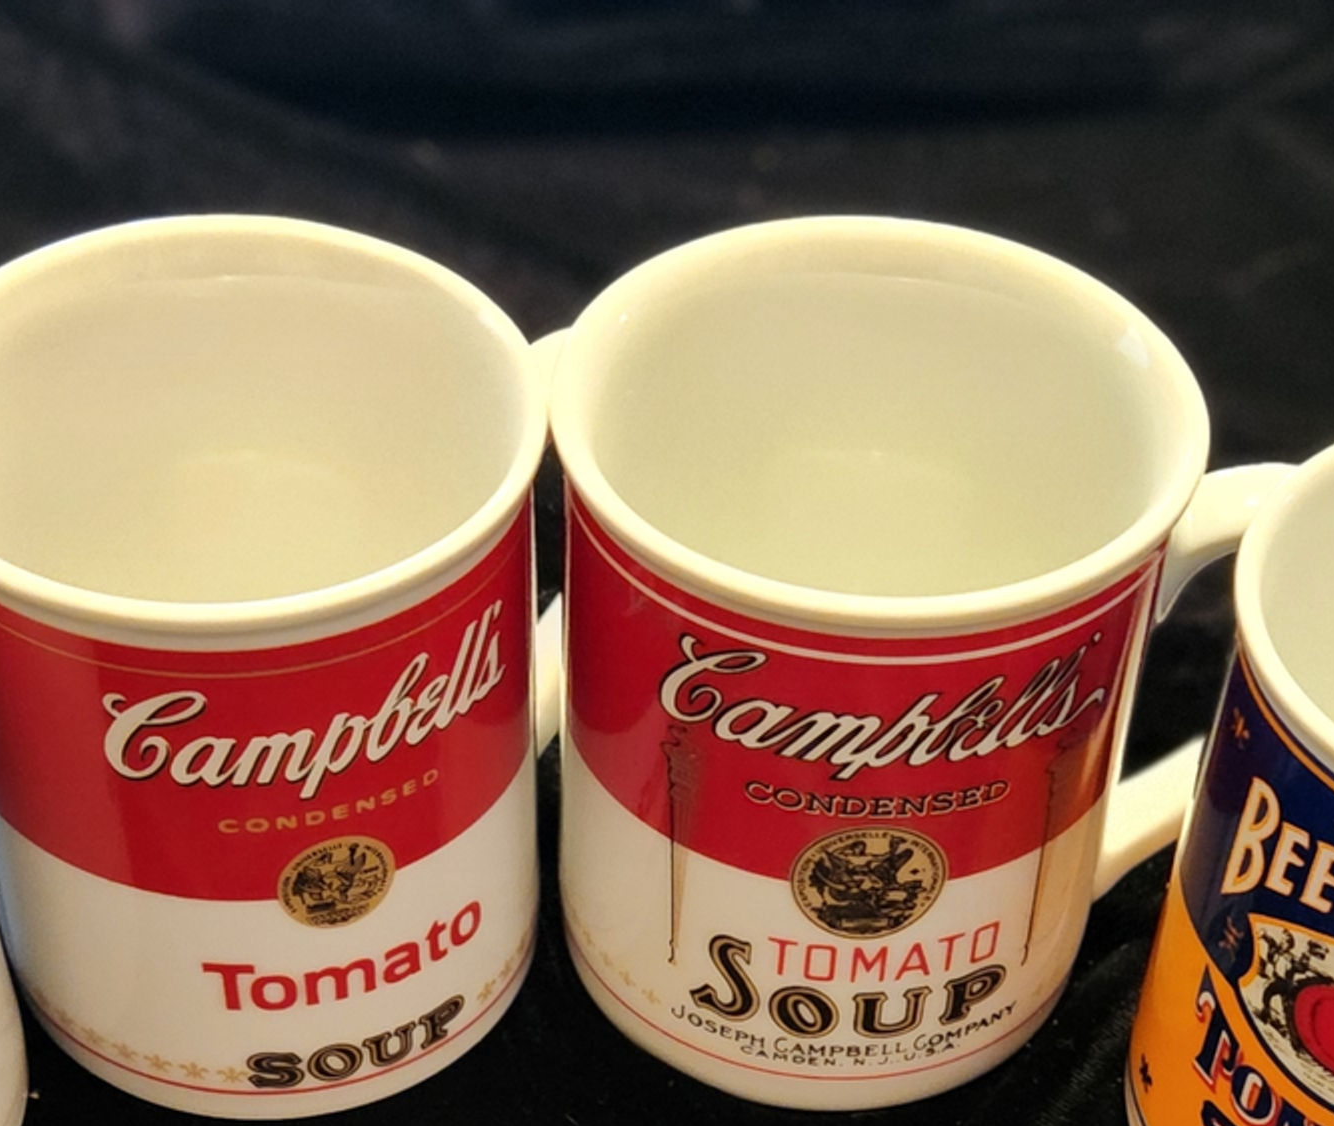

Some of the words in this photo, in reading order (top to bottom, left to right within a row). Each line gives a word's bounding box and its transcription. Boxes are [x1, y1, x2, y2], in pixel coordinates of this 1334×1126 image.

[217, 768, 441, 834] CONDENSED
[744, 780, 1010, 818] CONDENSED
[202, 901, 483, 1011] Tomato
[768, 921, 1001, 983] TOMATO
[688, 933, 1008, 1038] SOUP
[245, 994, 466, 1089] SOUP
[670, 1004, 765, 1048] JOSEPH
[773, 1036, 906, 1057] CAMPBELL
[913, 1001, 1017, 1050] COMPANY
